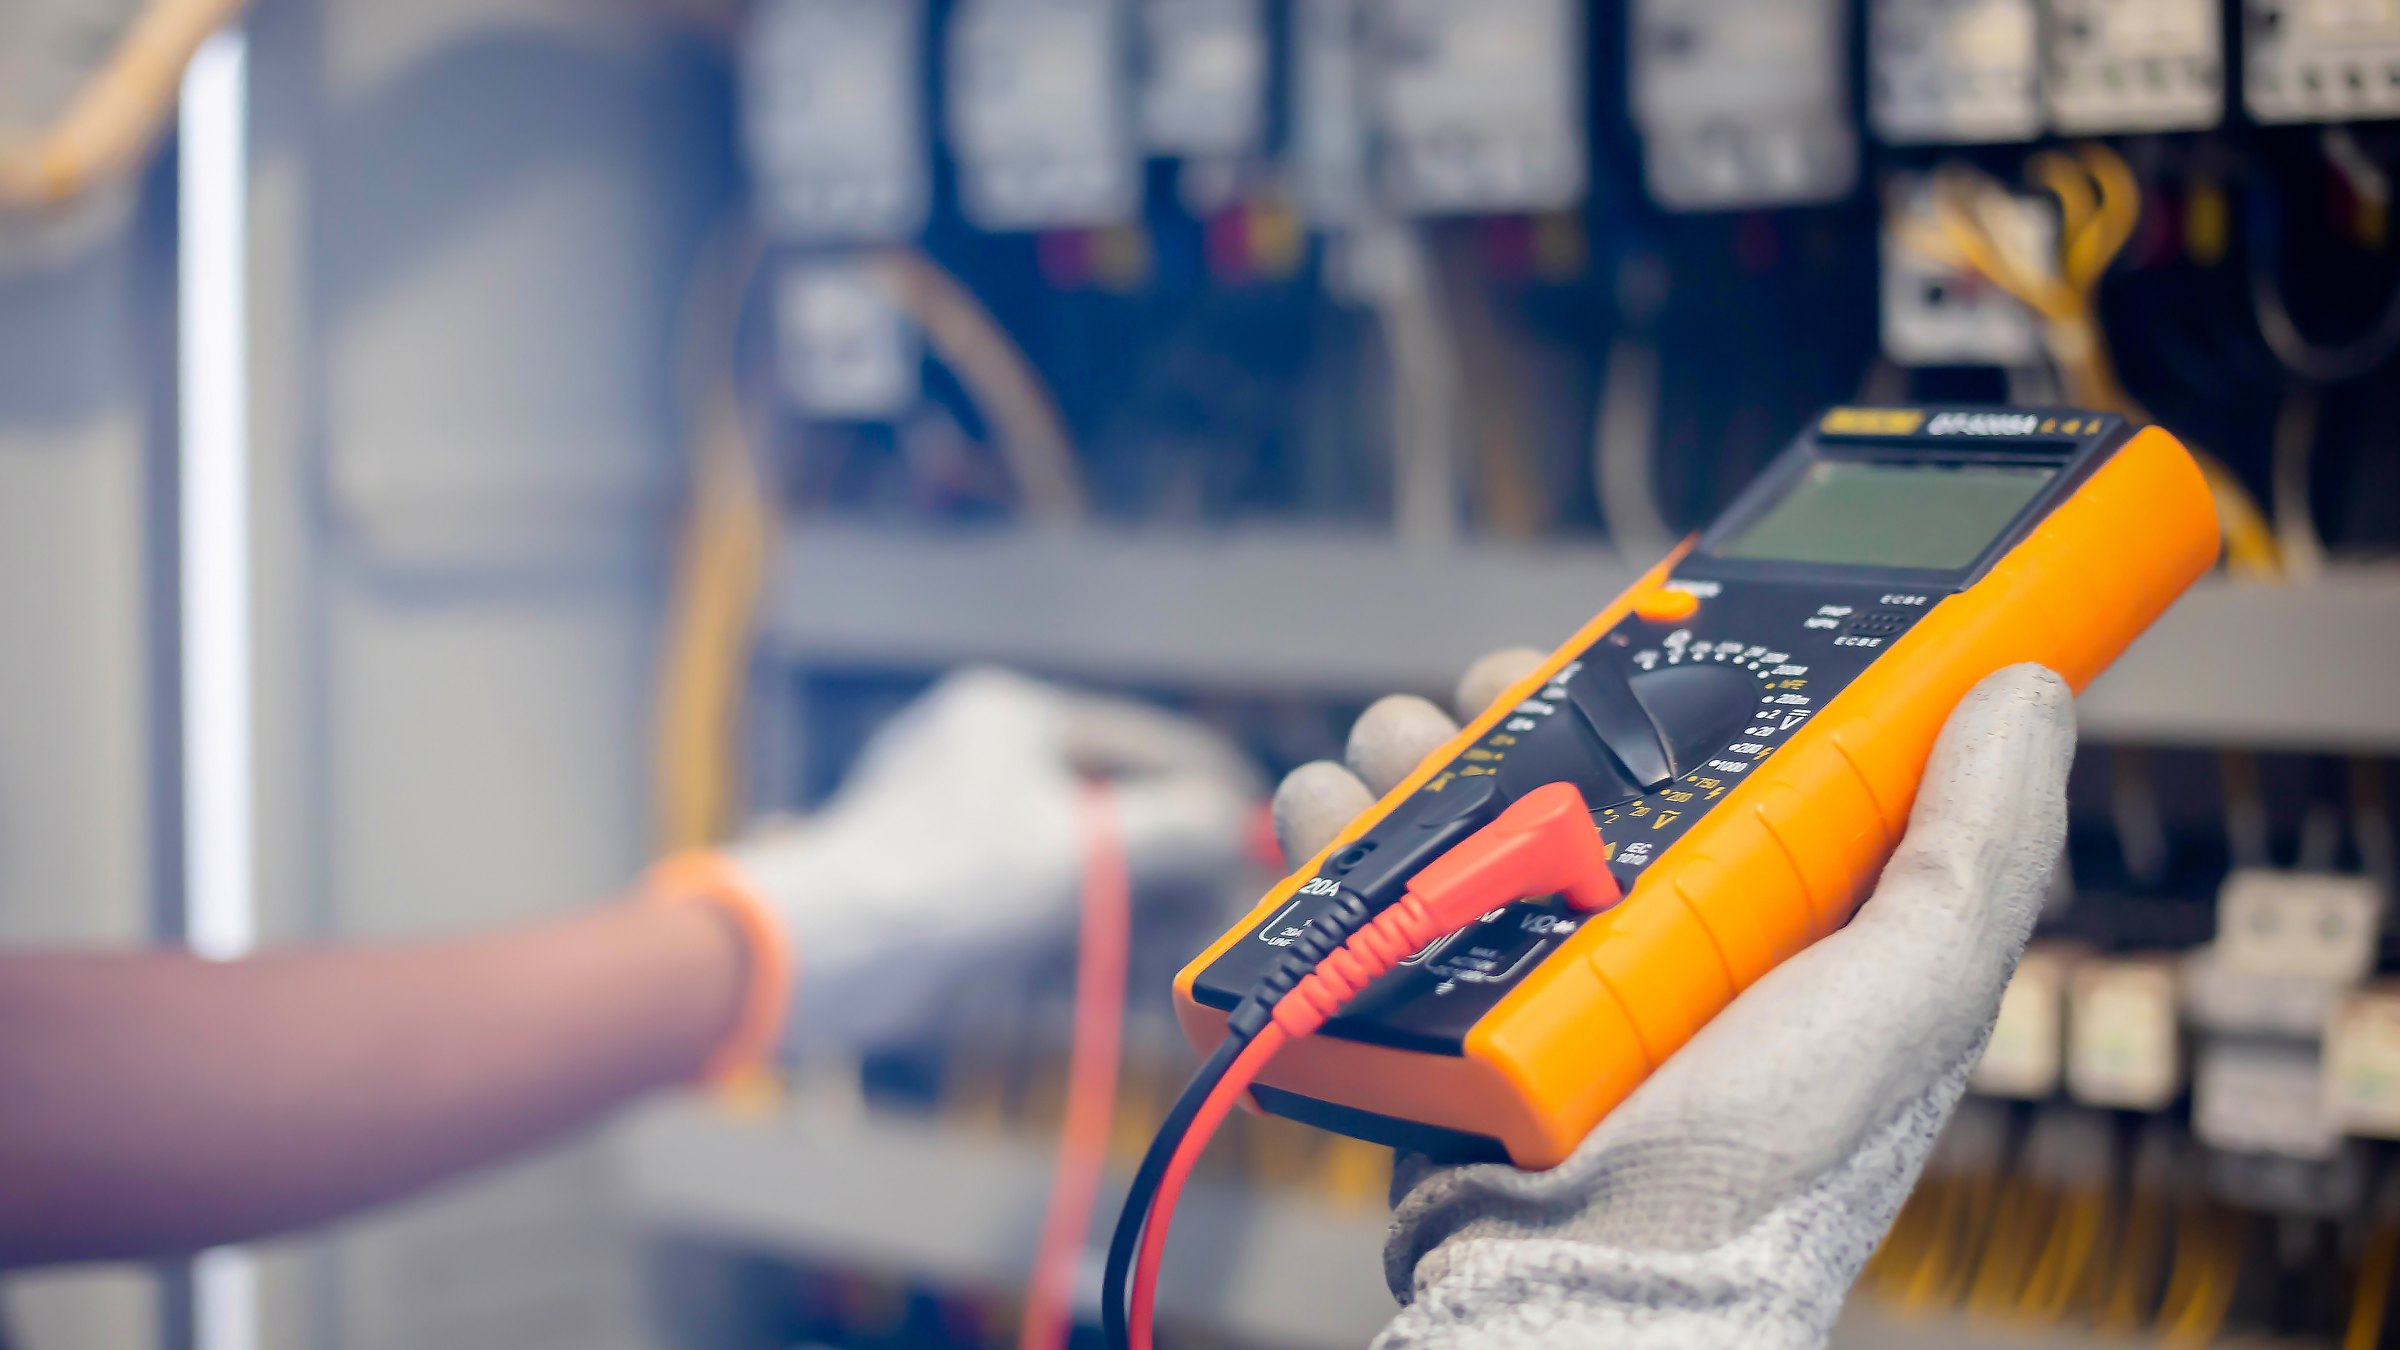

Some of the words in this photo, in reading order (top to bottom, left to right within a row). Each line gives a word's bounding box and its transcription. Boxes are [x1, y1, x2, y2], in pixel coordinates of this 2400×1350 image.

[1833, 636, 1881, 647] ECBE
[1765, 709, 1781, 719] 2
[1752, 726, 1776, 737] 20
[1733, 742, 1763, 754] 200
[1715, 760, 1748, 773] 1000
[1694, 777, 1721, 789] 750
[1663, 791, 1693, 803] 200
[1628, 806, 1652, 817] 20
[1603, 814, 1620, 824] 2
[1624, 842, 1653, 854] IEC
[1299, 877, 1341, 897] 20A
